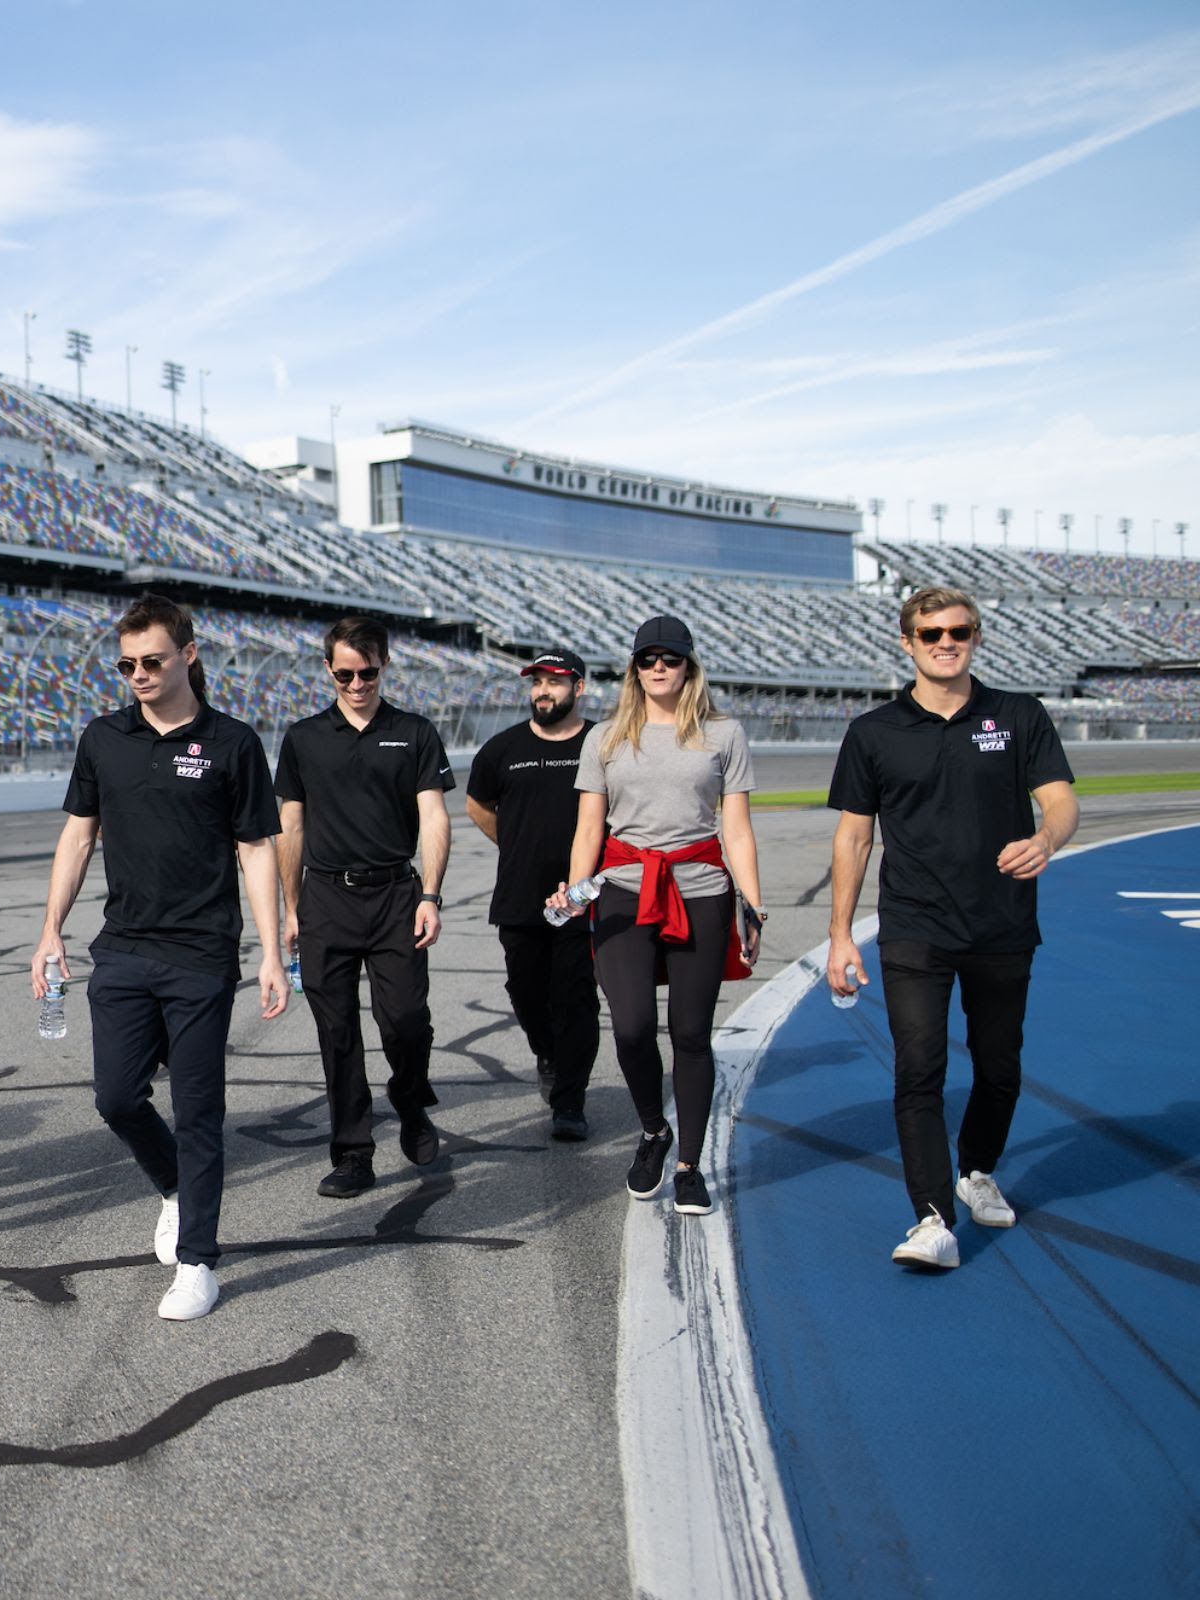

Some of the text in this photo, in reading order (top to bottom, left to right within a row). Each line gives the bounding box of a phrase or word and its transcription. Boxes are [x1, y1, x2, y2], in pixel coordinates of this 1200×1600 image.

[533, 464, 752, 516] WORLD CENTER OF RACING
[971, 731, 1011, 741] ANDRETTI
[979, 741, 1005, 752] WTR
[173, 755, 211, 766] ANDRETTI
[514, 759, 581, 769] ACURA MOTORSP
[176, 766, 203, 778] WTR
